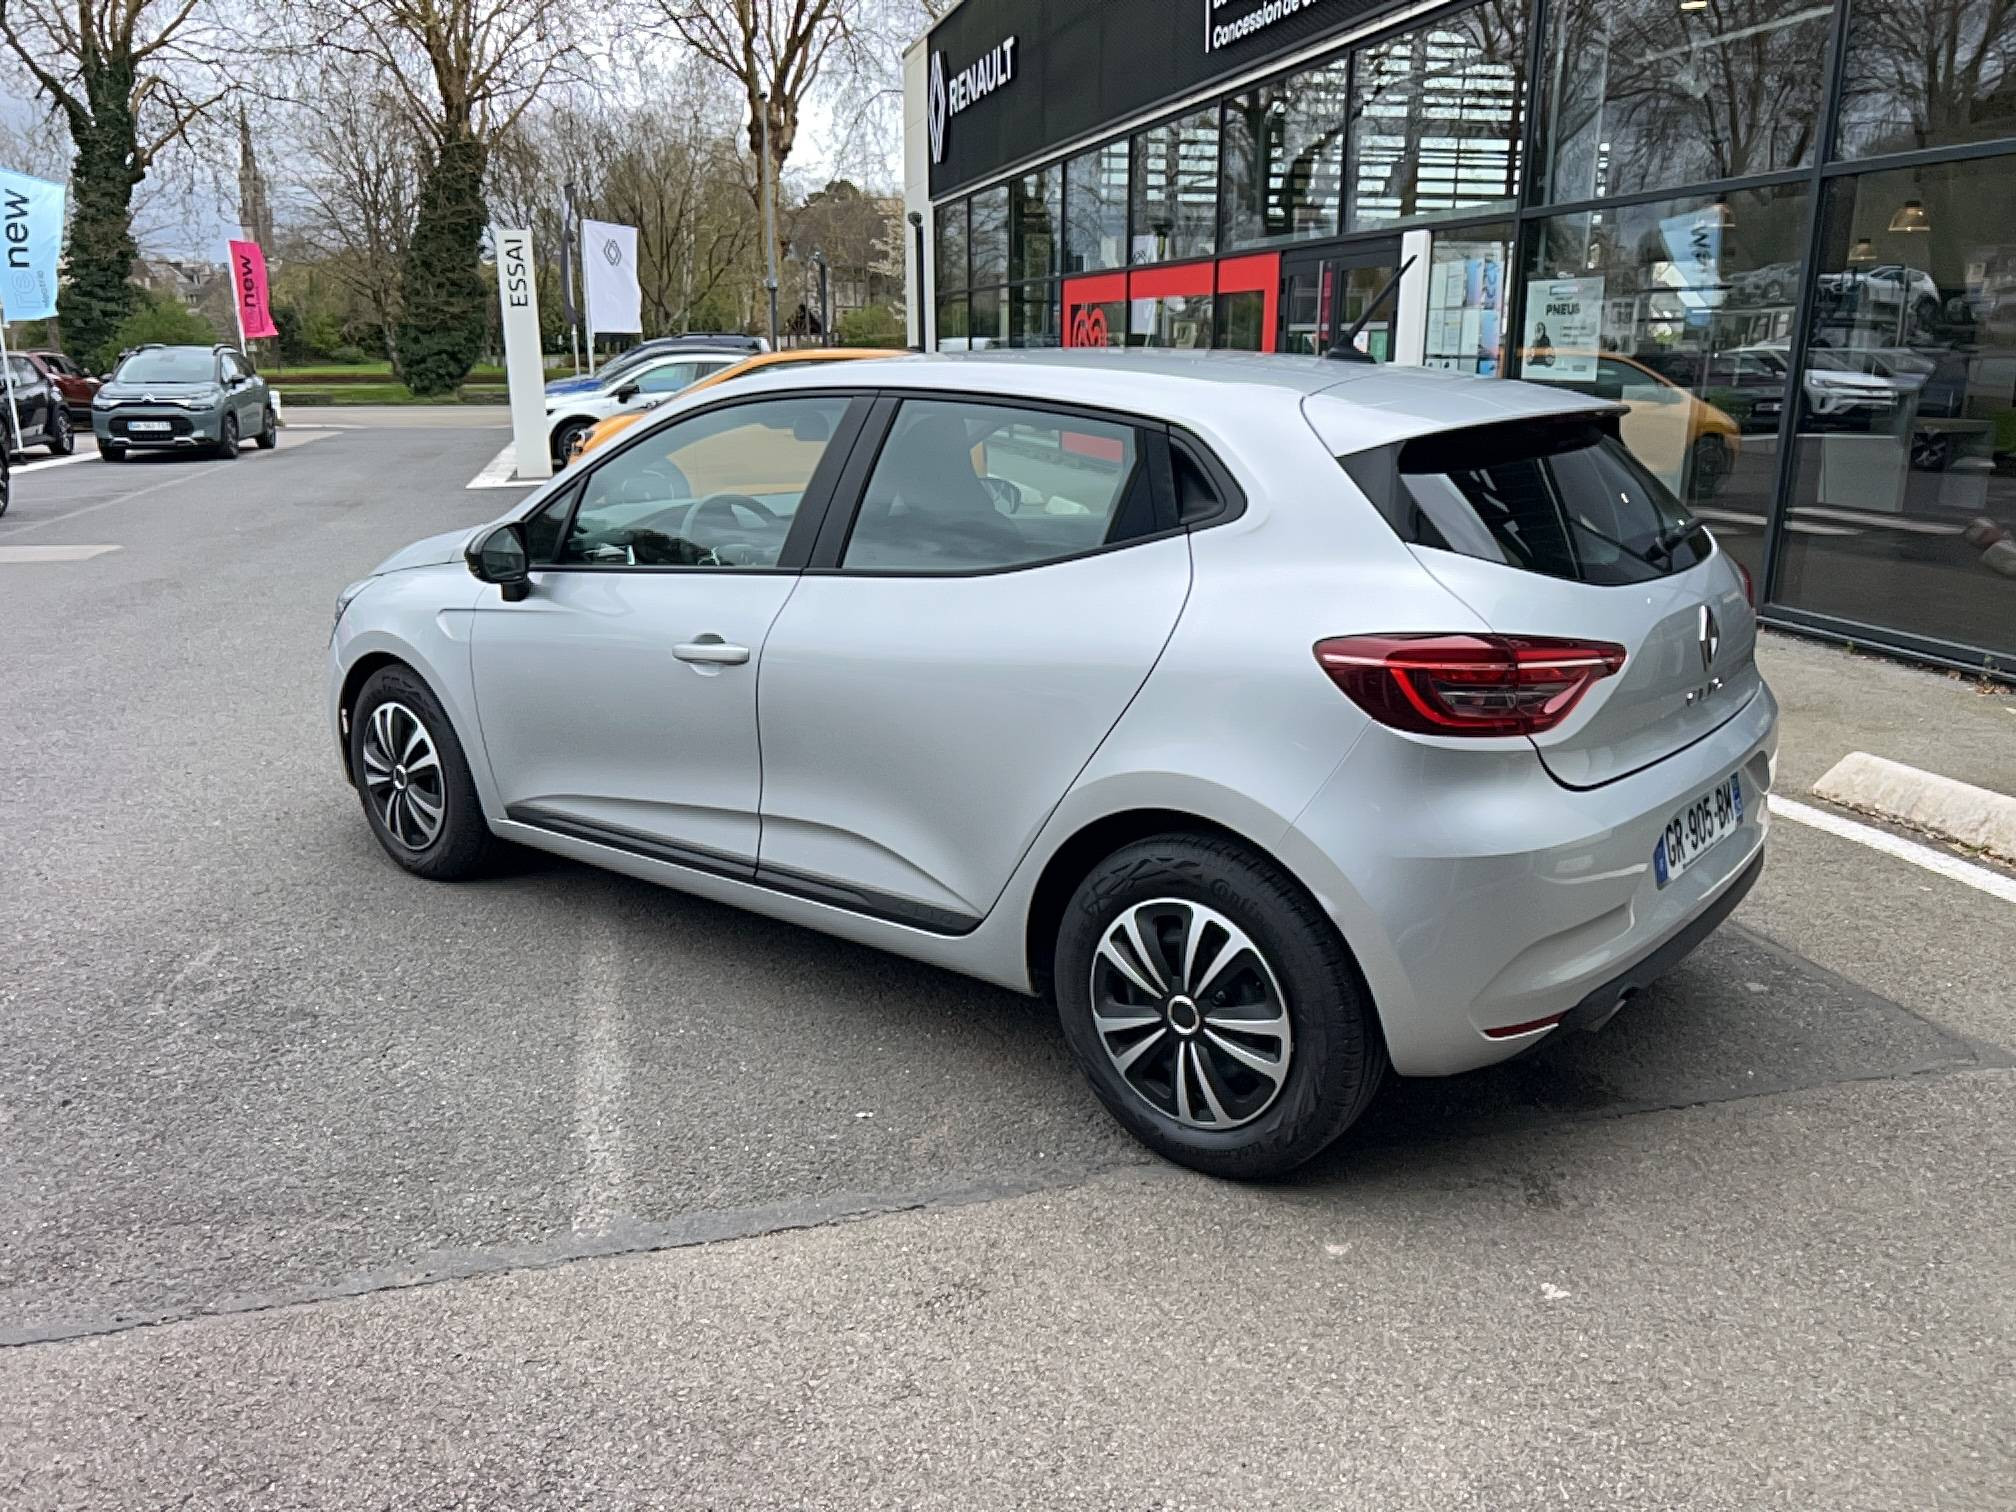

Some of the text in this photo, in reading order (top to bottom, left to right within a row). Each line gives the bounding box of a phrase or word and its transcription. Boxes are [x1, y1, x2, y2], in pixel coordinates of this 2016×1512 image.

[1213, 0, 1282, 48] Concession
[949, 35, 1015, 117] RENAULT
[504, 239, 529, 307] ESSAI
